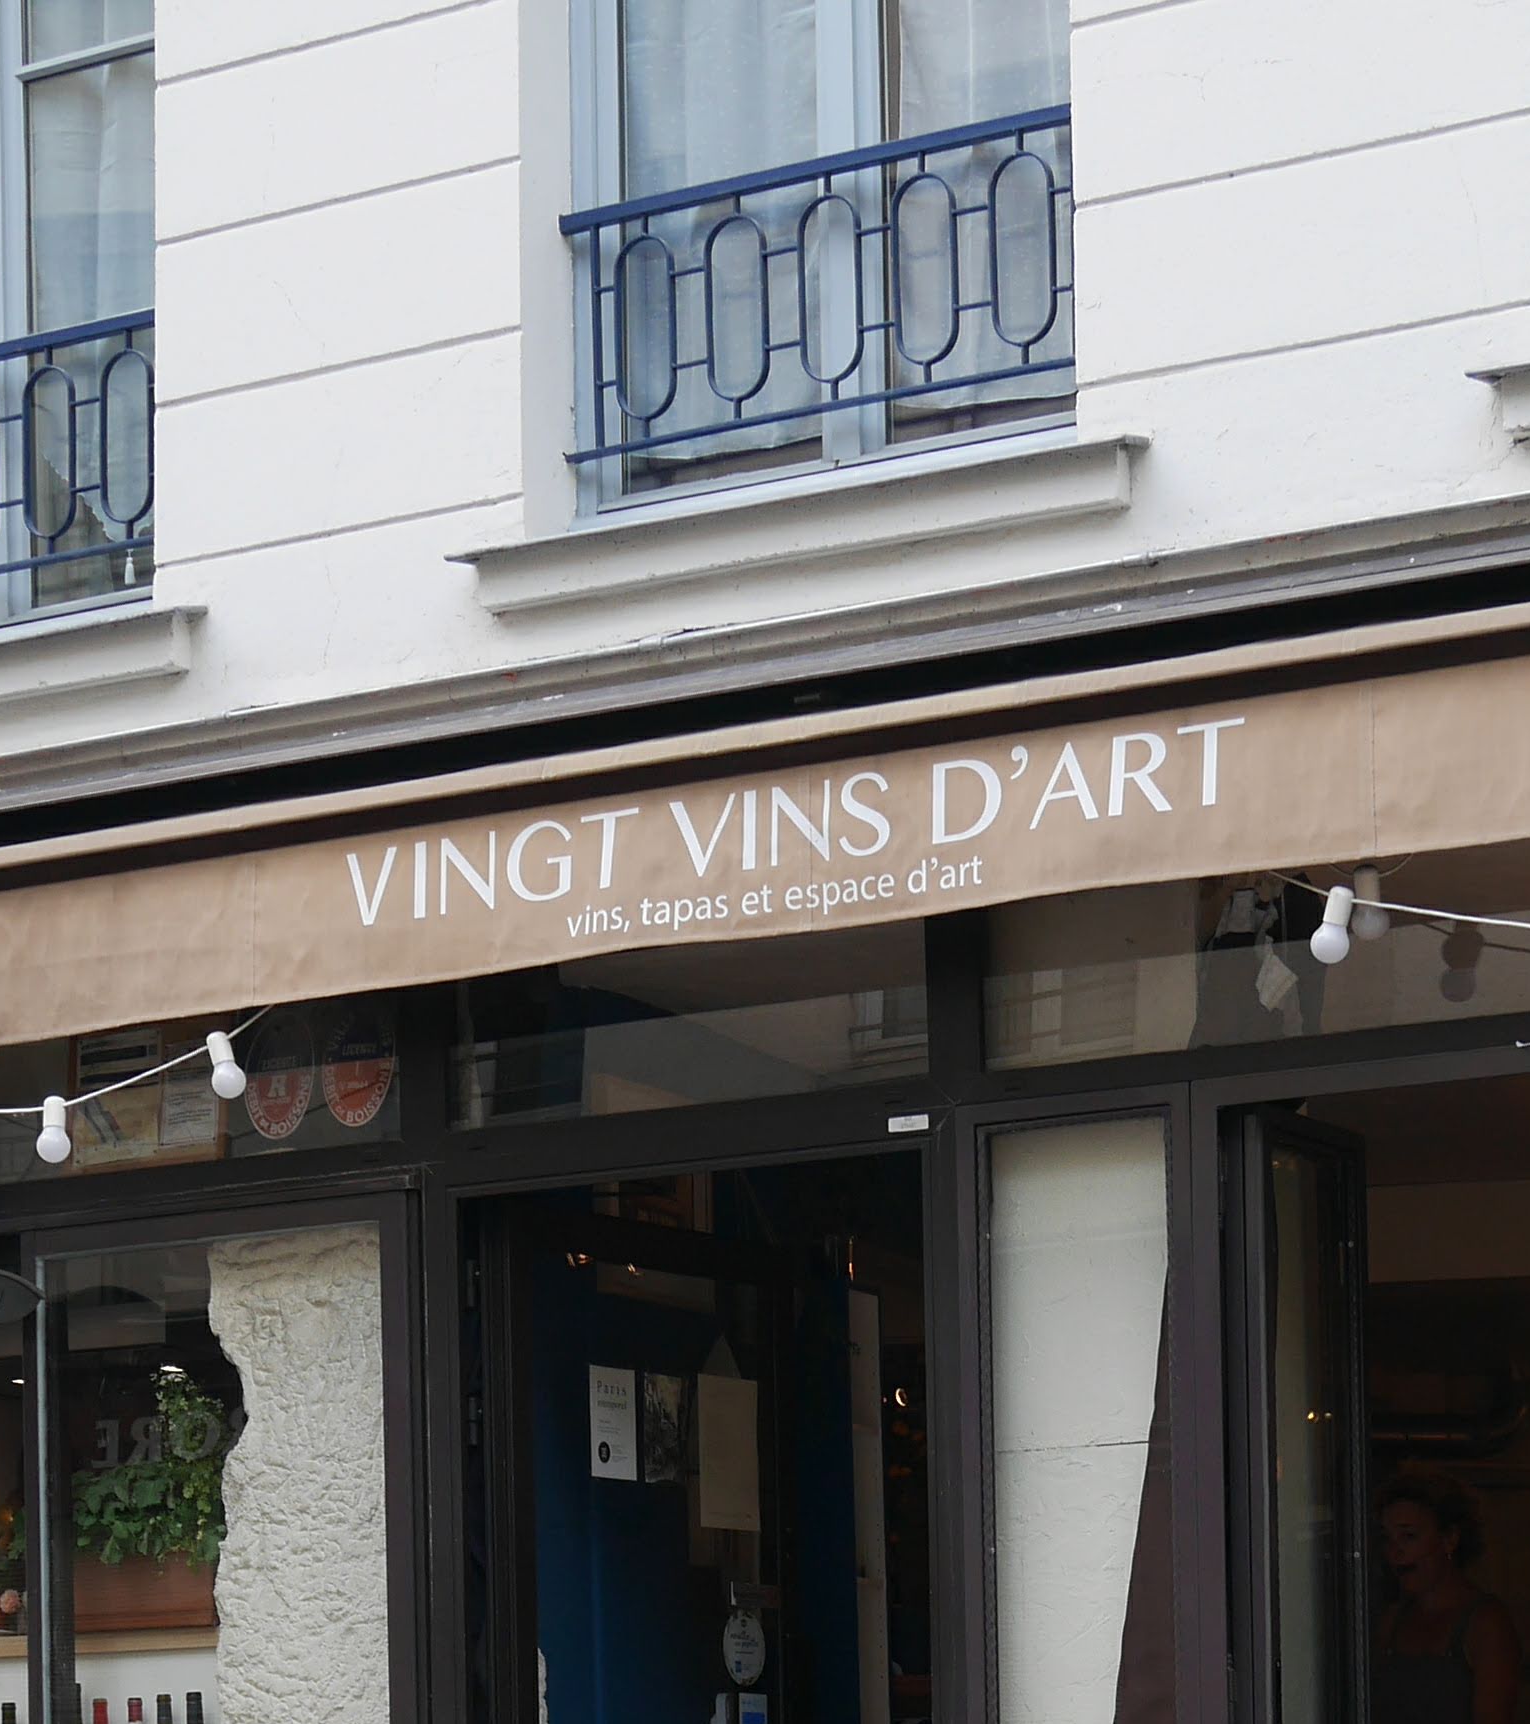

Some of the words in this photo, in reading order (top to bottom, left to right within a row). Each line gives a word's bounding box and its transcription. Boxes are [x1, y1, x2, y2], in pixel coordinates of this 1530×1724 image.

[345, 806, 640, 927] VINGT
[668, 770, 891, 879] VINS
[931, 716, 1246, 846] D'ART
[566, 900, 631, 939] vins,
[639, 893, 729, 932] tapas
[740, 883, 773, 916] et
[784, 872, 896, 916] espace
[907, 854, 984, 895] d'art
